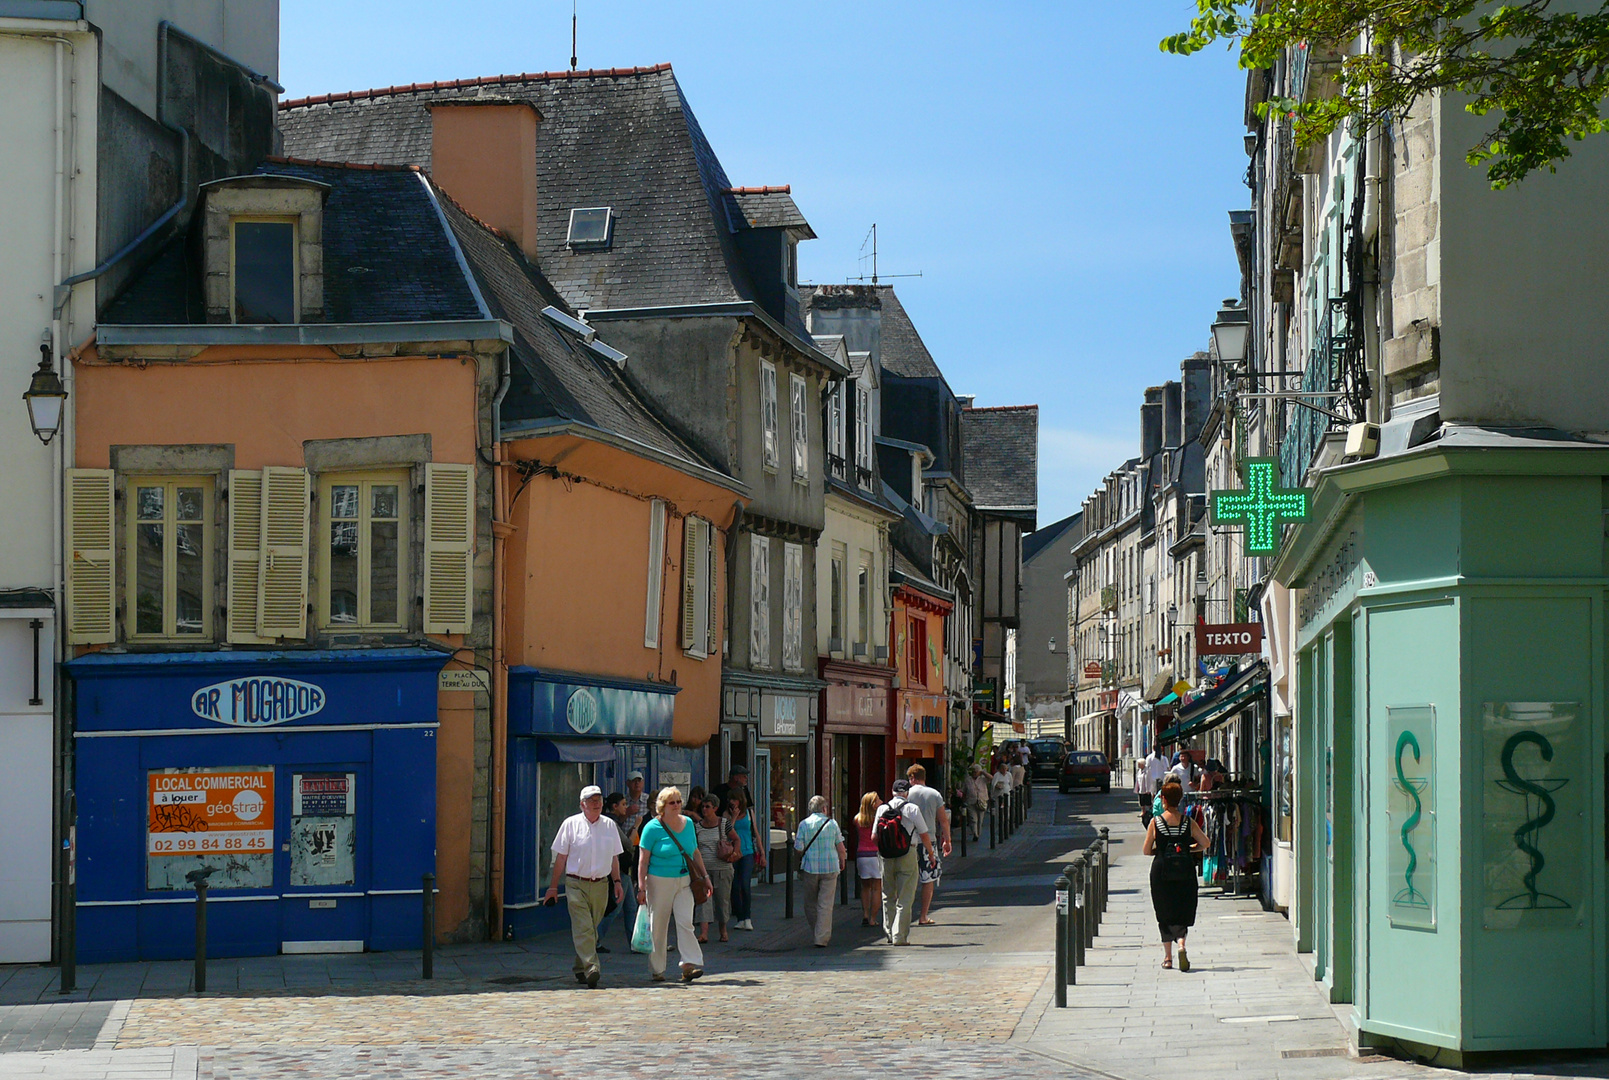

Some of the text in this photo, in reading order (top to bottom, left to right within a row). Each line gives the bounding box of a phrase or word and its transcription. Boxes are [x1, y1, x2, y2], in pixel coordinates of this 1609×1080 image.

[1206, 632, 1252, 646] TEXTO
[196, 679, 322, 724] AR MOGADOR
[155, 775, 267, 791] LOCAL COMMERCIAL
[162, 793, 199, 802] à louer
[206, 801, 264, 817] géostrat
[154, 837, 266, 851] 02 99 84 88 45
